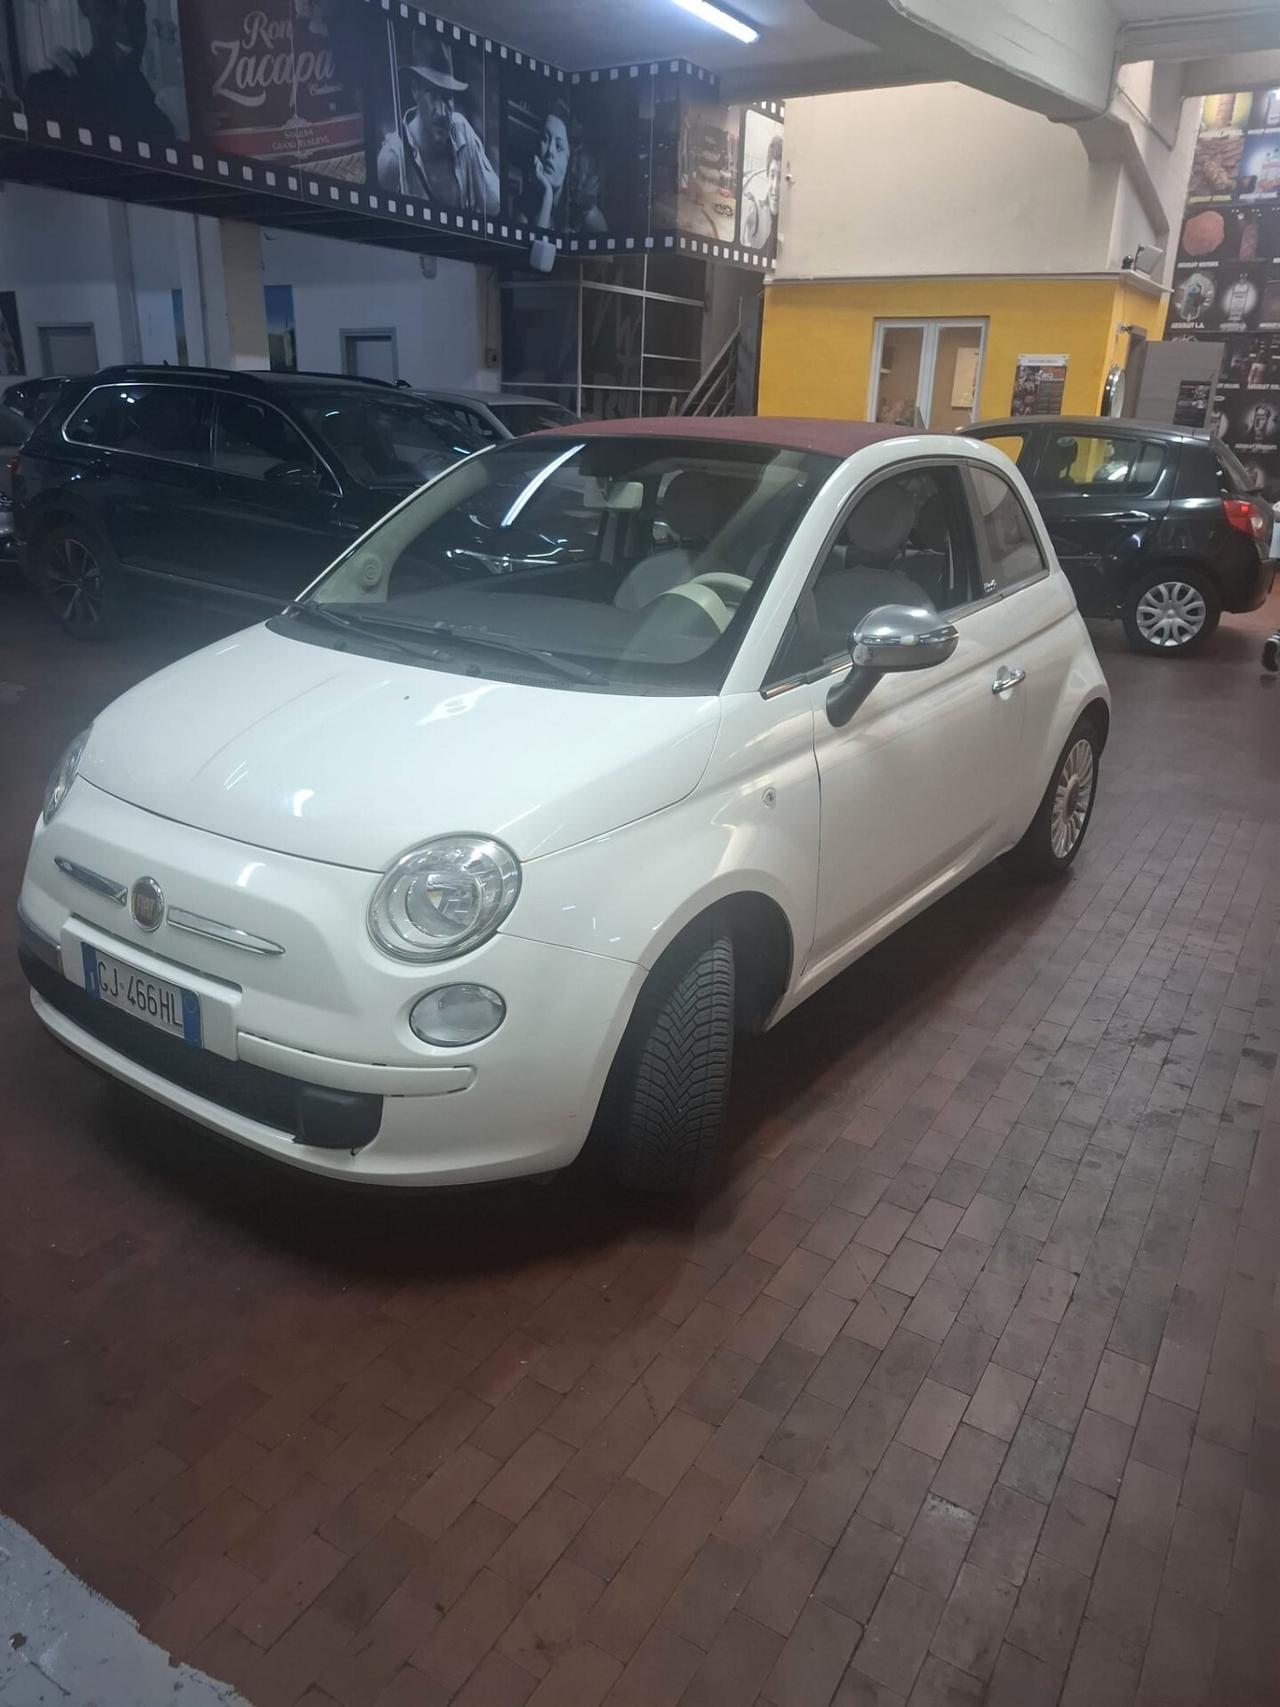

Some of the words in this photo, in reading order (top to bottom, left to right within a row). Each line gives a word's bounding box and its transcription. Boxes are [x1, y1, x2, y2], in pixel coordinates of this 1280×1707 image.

[242, 10, 294, 49] Ron
[211, 40, 336, 107] Zacapa
[126, 975, 183, 1027] 466HL
